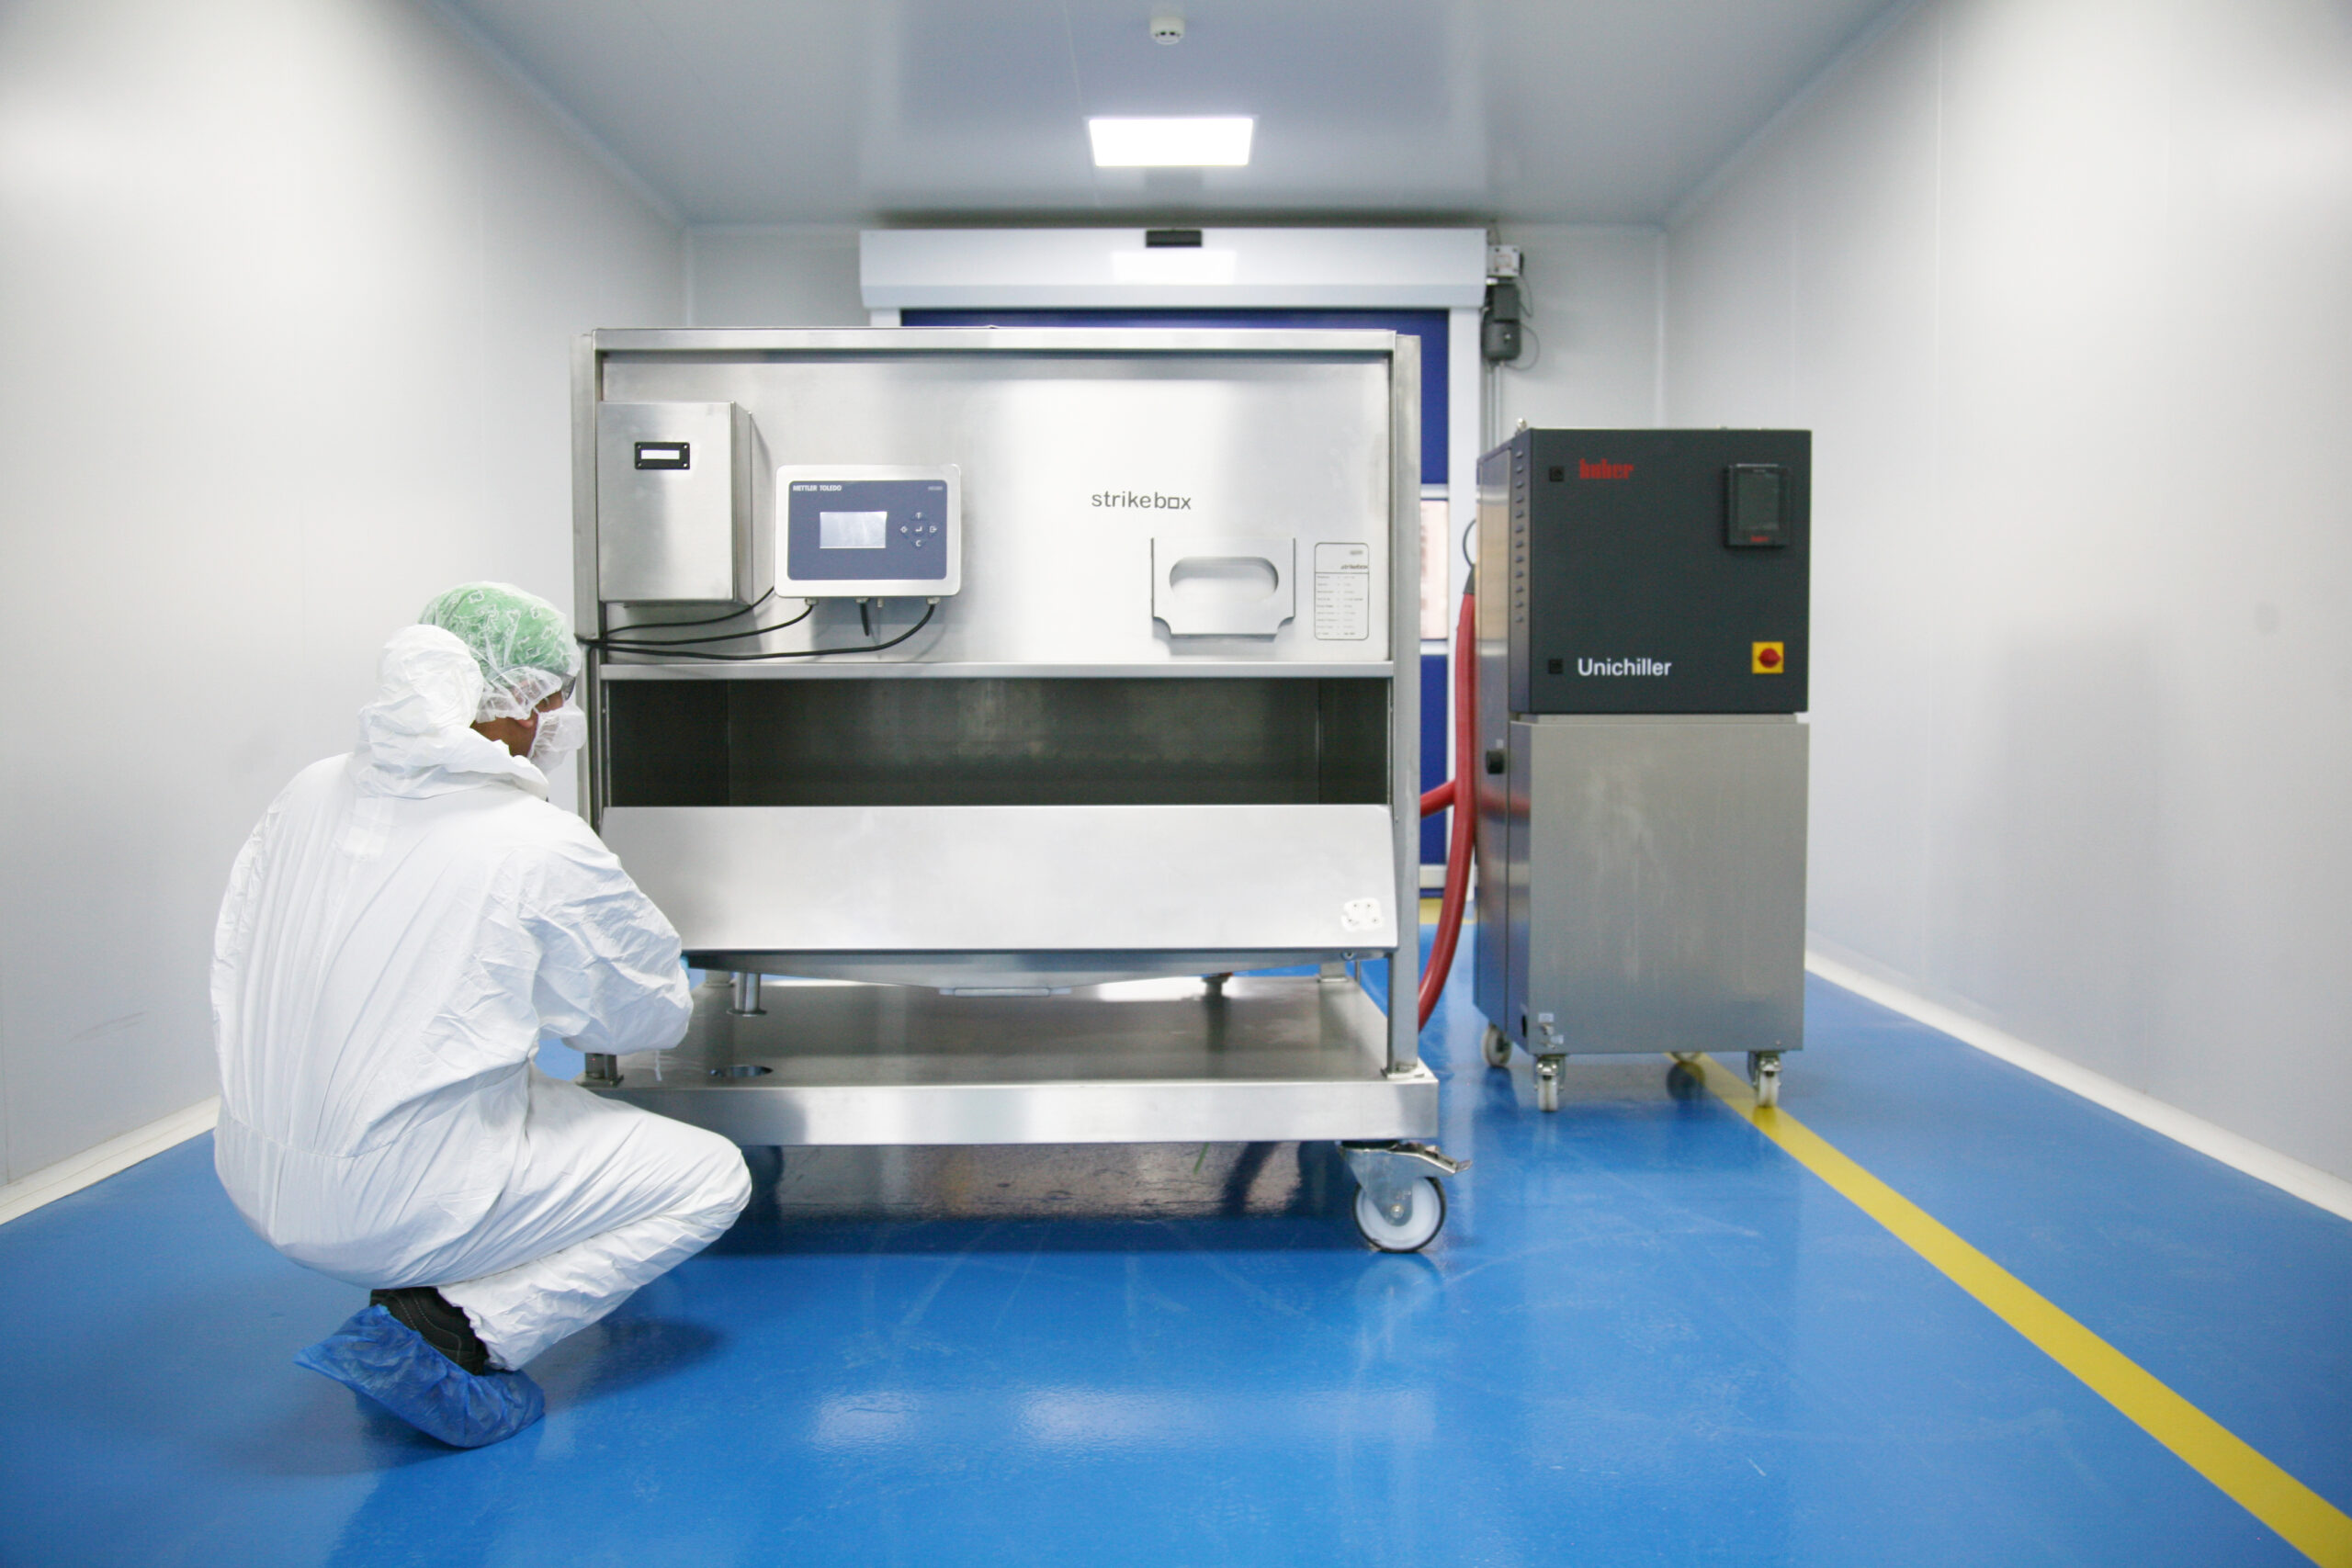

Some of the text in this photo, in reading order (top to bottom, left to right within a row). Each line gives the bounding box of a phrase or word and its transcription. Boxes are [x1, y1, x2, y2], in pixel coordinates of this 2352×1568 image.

[1579, 457, 1634, 479] huber
[1091, 491, 1192, 510] strikebox
[1577, 658, 1671, 676] Unichiller
